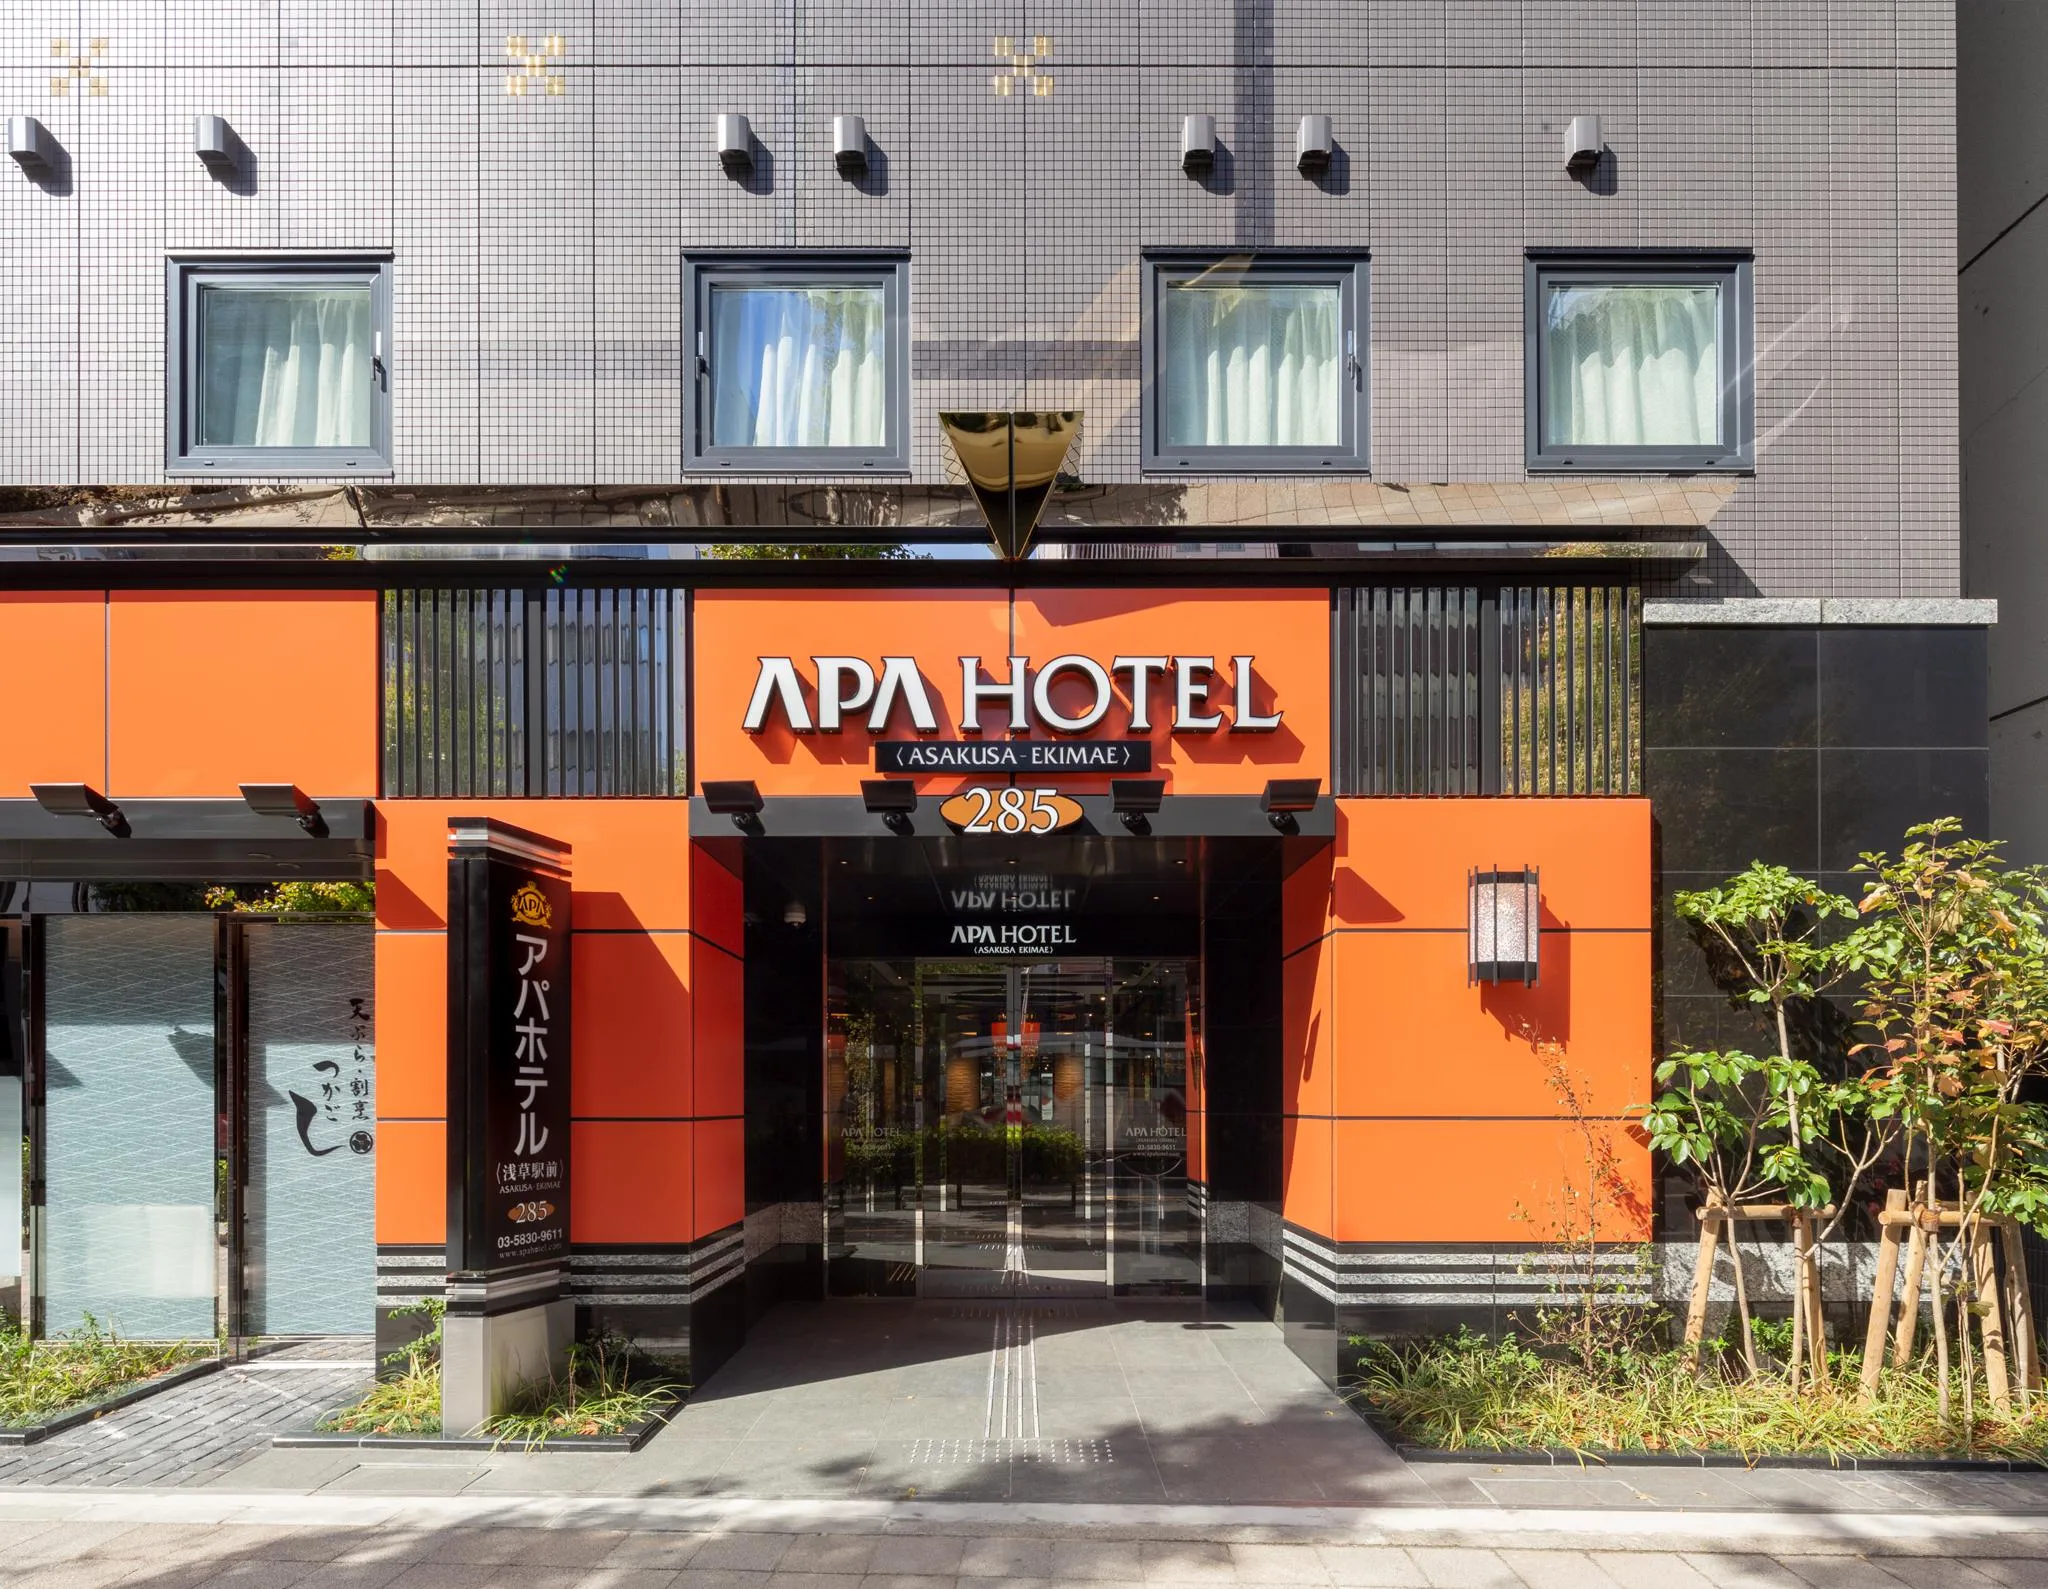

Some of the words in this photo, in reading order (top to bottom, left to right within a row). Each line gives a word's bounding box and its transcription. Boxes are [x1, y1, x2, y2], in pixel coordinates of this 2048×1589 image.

[742, 656, 938, 734] APA
[958, 654, 1284, 734] HOTEL
[962, 786, 1059, 834] 285
[950, 925, 996, 943] APA
[1001, 925, 1077, 943] HOTEL
[513, 933, 550, 1157] アパホテル
[1125, 1127, 1148, 1137] APA
[1150, 1127, 1188, 1137] HOTEL
[516, 1200, 547, 1223] 285
[497, 1228, 562, 1249] 03-5830-9611
